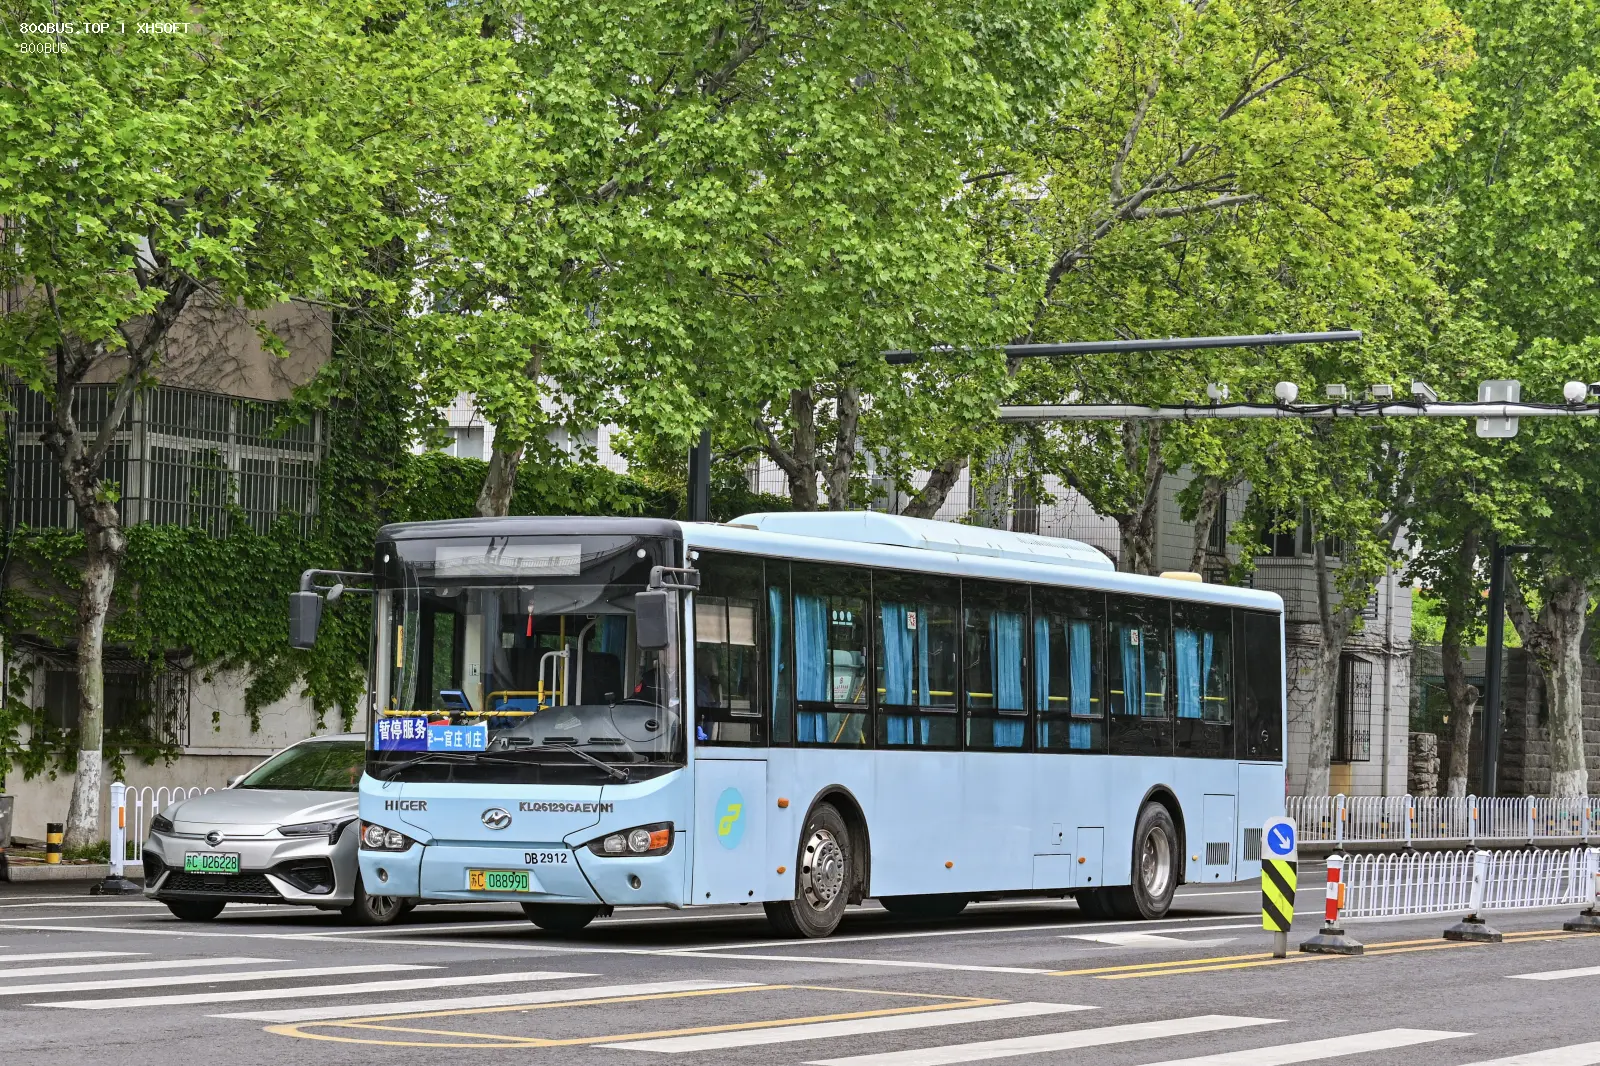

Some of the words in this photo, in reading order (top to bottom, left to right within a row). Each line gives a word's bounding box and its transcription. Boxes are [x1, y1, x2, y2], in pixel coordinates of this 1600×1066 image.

[379, 719, 427, 740] 暂停服务
[385, 800, 428, 811] HIGER
